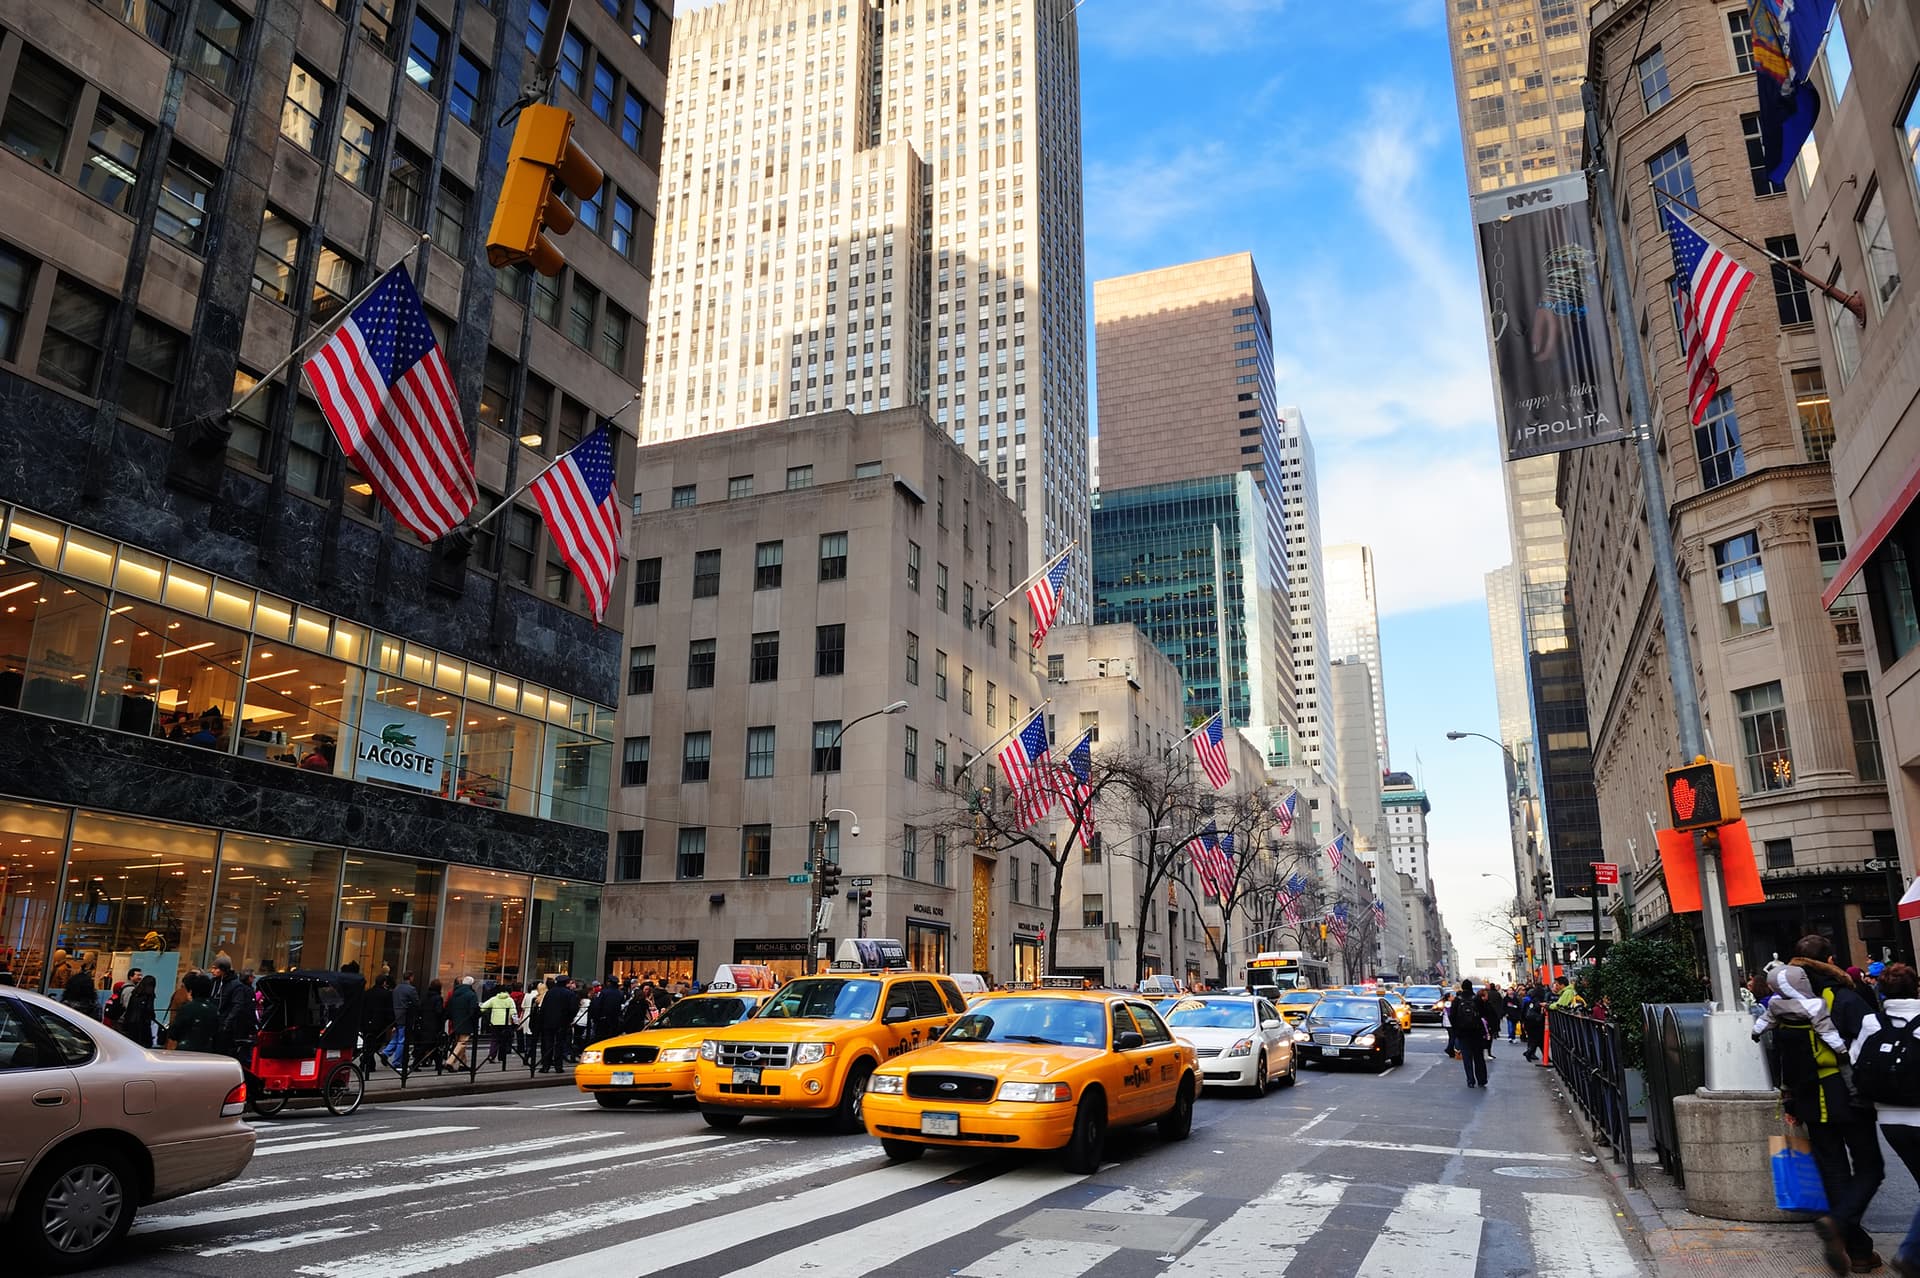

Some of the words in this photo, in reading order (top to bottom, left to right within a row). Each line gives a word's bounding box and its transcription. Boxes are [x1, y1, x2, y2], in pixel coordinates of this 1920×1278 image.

[1506, 188, 1553, 210] NYC
[1517, 413, 1610, 440] IPPOLITA
[358, 742, 434, 775] LACOSTE
[914, 904, 932, 915] MICHAEL
[932, 908, 944, 916] KORS
[755, 943, 788, 951] MICHAEL
